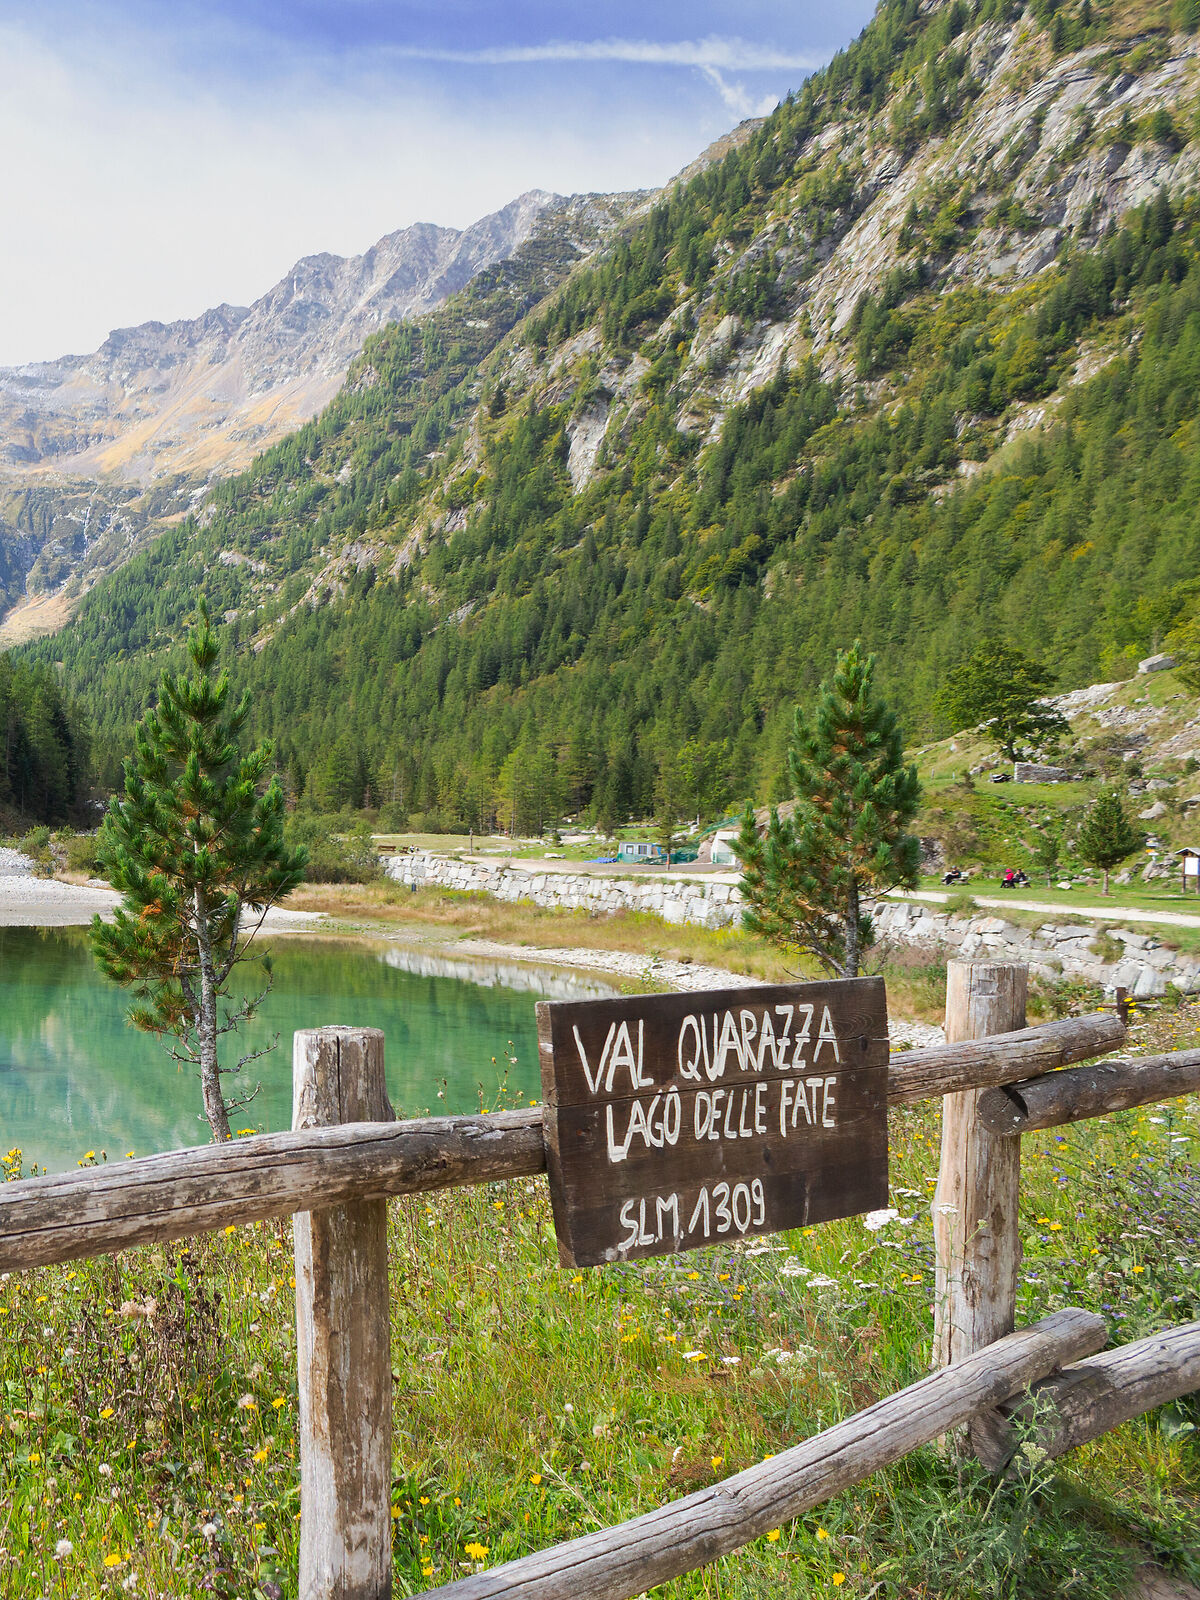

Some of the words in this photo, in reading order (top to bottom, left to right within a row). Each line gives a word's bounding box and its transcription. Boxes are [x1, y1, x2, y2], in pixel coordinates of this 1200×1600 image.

[573, 1019, 654, 1094] VAL
[677, 1003, 840, 1082] QUARAZZA
[606, 1085, 681, 1162] LAGO
[694, 1083, 767, 1140] DELLE
[780, 1077, 837, 1137] FATE
[688, 1178, 765, 1238] 1309
